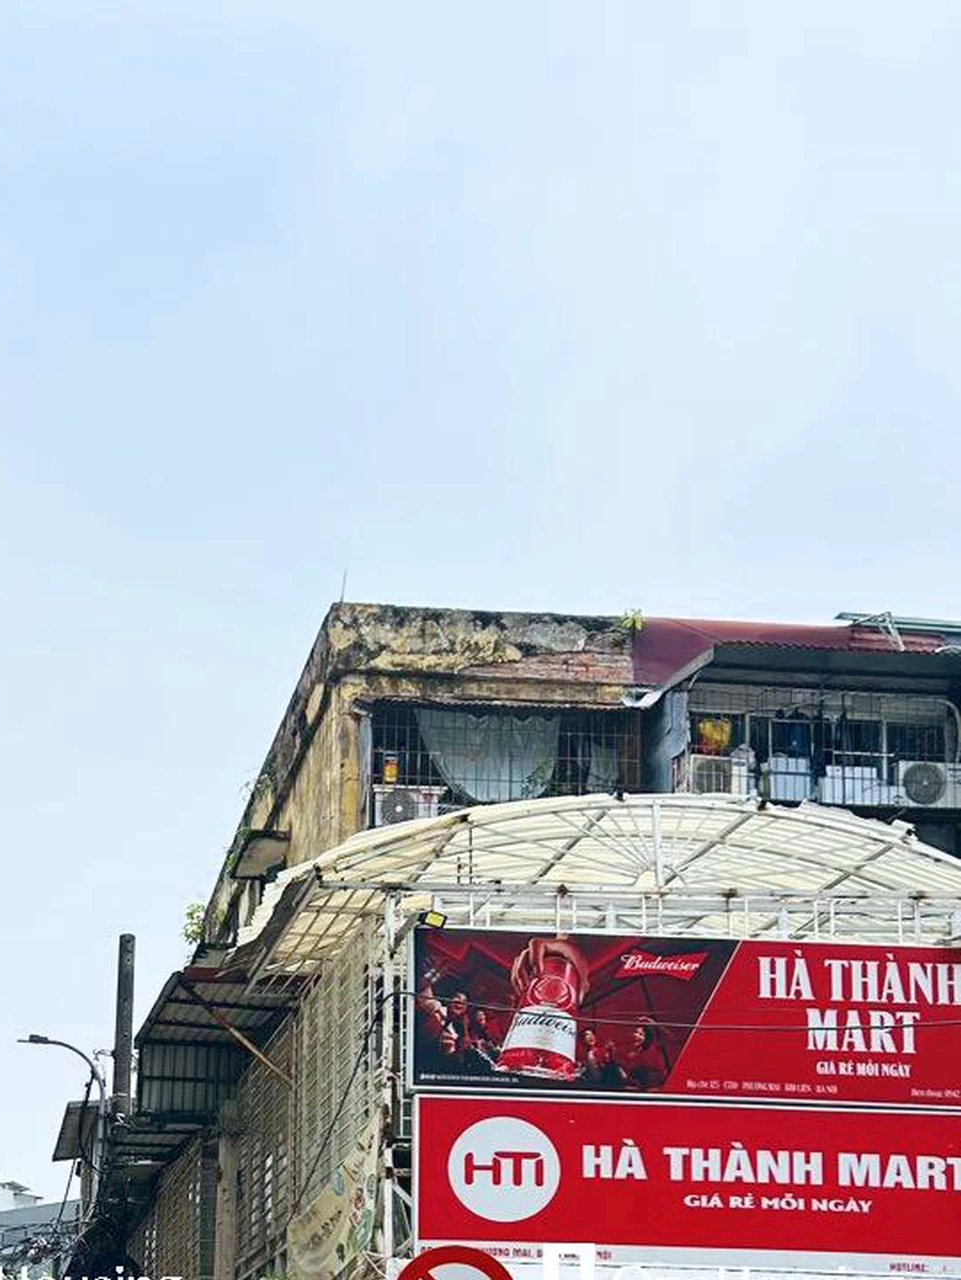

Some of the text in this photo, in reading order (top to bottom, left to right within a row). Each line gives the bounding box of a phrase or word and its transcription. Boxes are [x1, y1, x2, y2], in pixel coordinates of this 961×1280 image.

[621, 954, 700, 971] Budweiser
[758, 950, 961, 1006] HÀ THÀNH
[806, 1008, 921, 1054] MART
[881, 1062, 911, 1078] NGÀY
[582, 1138, 961, 1192] HÀ THÀNH MART
[683, 1192, 873, 1213] GIÁ RẺ MỖI NGÀY
